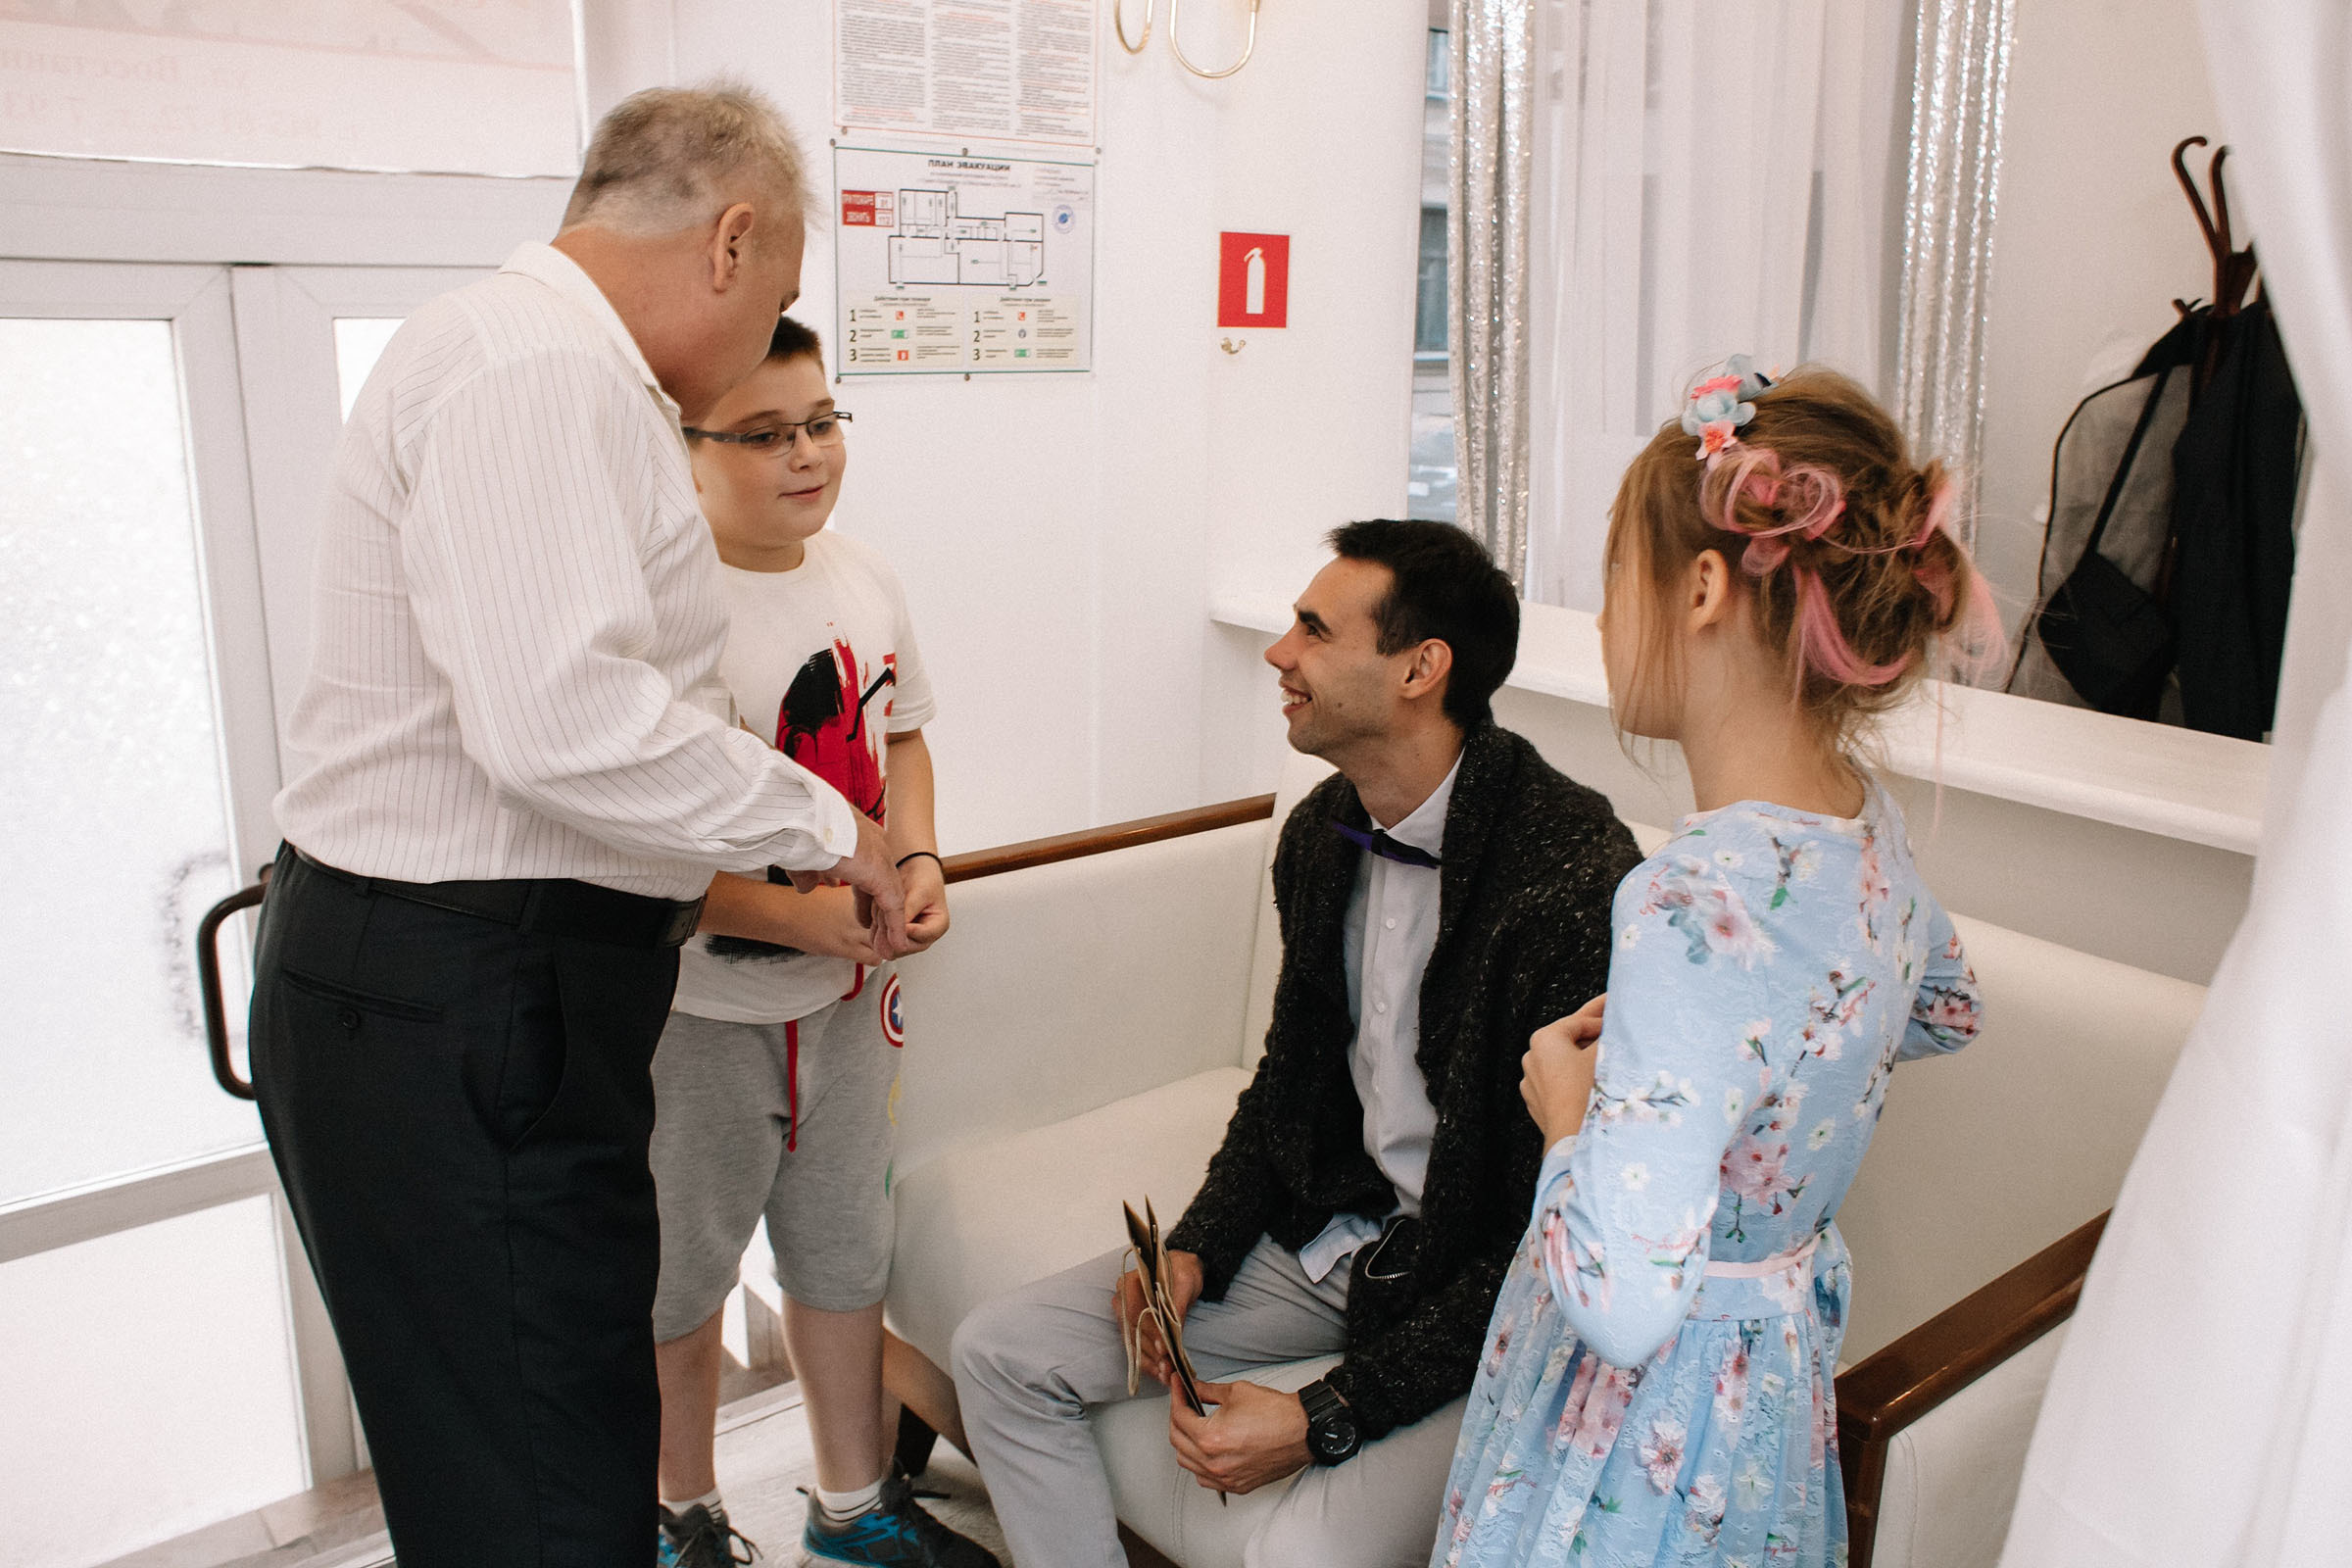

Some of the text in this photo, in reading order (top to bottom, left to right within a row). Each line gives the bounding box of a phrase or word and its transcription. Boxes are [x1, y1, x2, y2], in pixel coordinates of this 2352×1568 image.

[928, 159, 1011, 172] ПЛАН ЭВАКУАЦИИ
[850, 309, 857, 322] 1
[973, 311, 980, 323] 1
[849, 329, 858, 343] 2
[973, 330, 980, 343] 2
[849, 348, 858, 362] 3
[973, 348, 981, 361] 3
